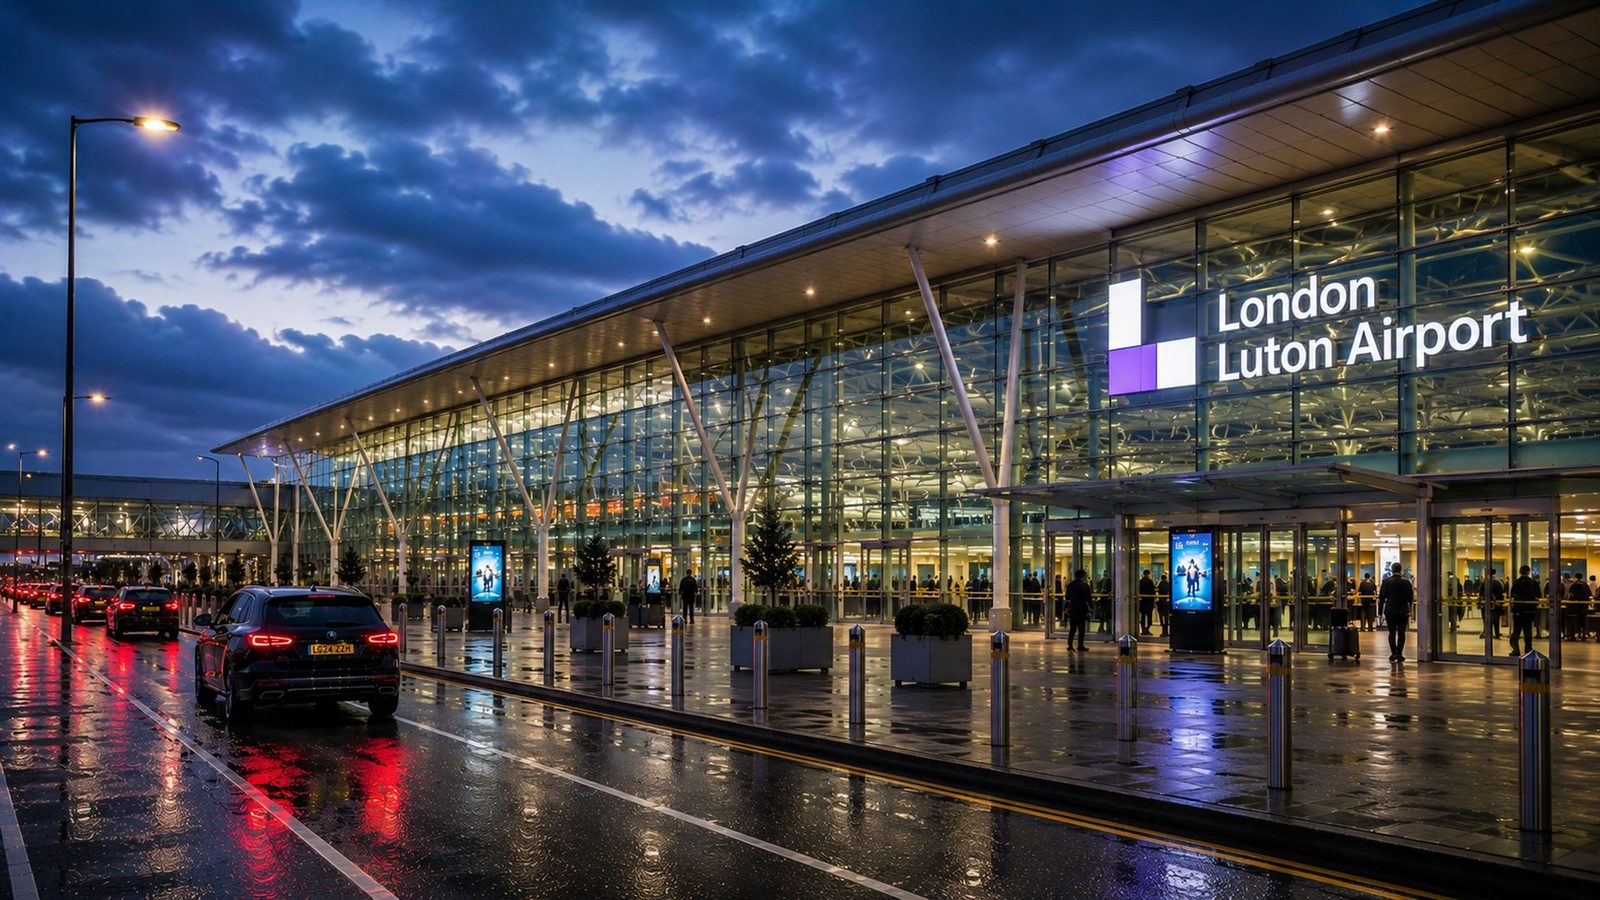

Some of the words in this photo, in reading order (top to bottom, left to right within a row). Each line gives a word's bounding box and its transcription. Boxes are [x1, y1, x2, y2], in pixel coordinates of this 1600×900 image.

[1218, 275, 1376, 333] London
[1218, 337, 1334, 382] Luton
[1346, 300, 1529, 368] Airport
